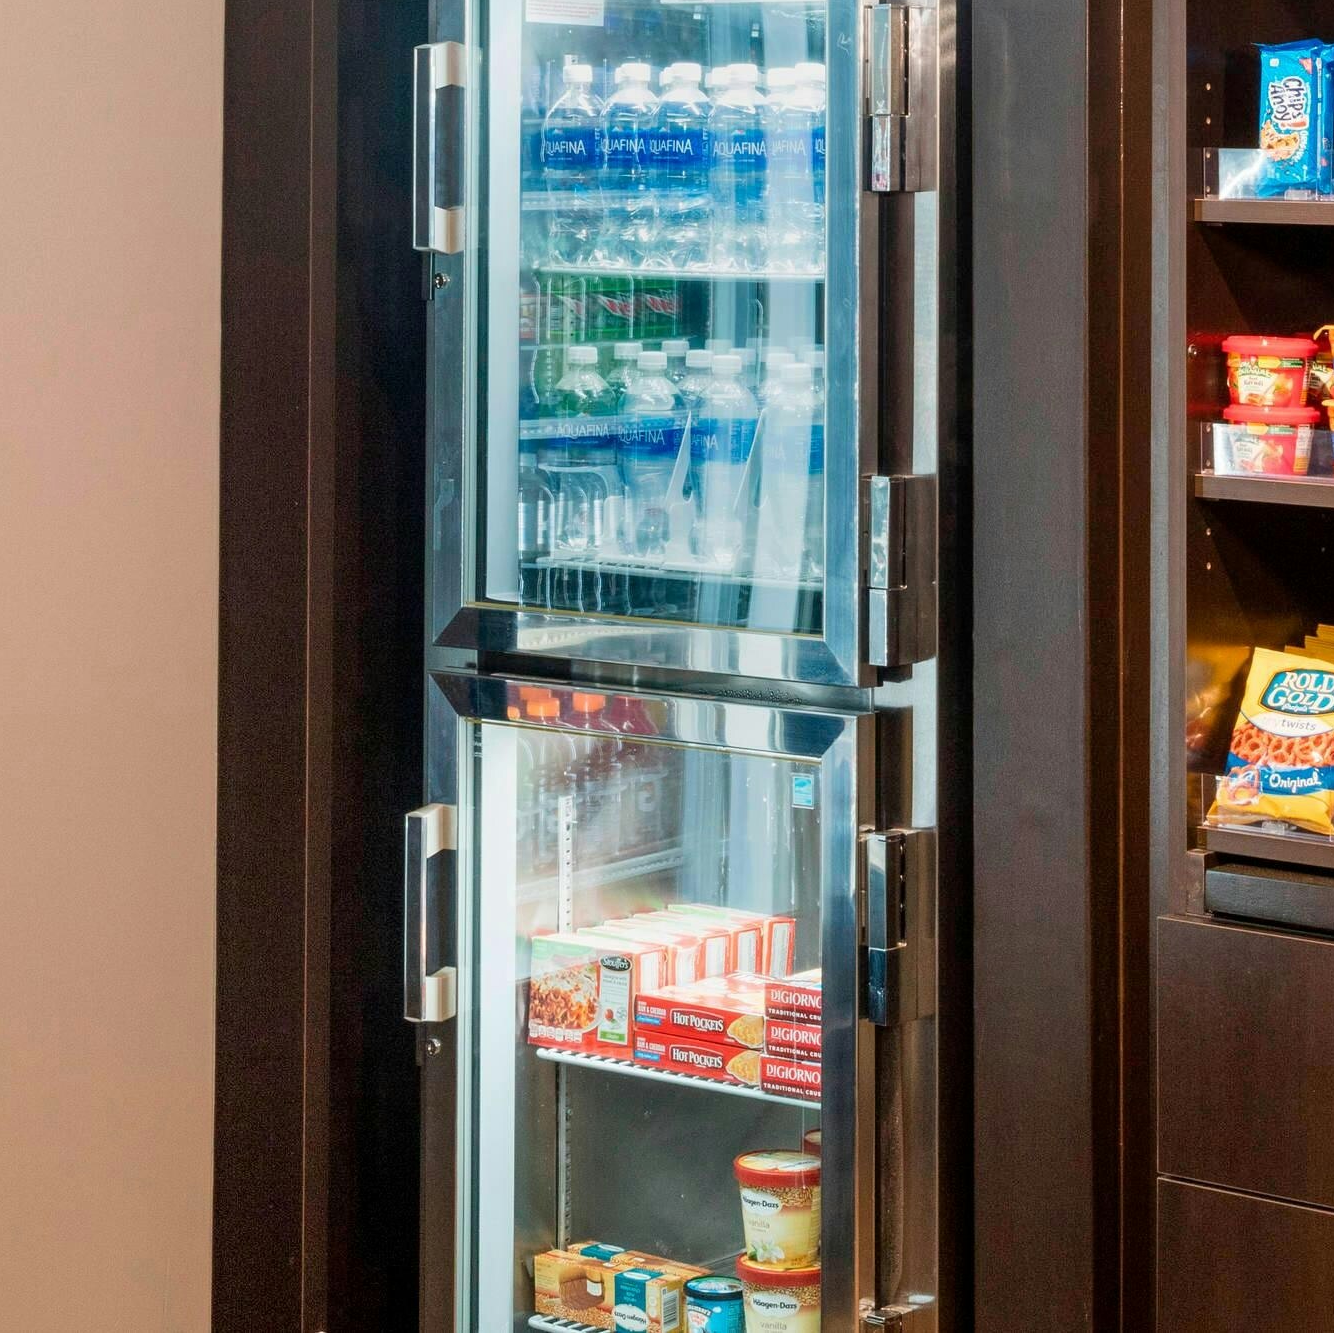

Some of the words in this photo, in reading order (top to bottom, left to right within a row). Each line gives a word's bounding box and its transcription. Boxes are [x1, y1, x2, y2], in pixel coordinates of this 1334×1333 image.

[1282, 76, 1306, 120] Chips
[546, 139, 588, 156] QUAFINA
[649, 138, 694, 156] QUAFINA
[712, 140, 768, 158] AQUAFINA
[1280, 718, 1317, 731] twists
[1269, 771, 1322, 793] Original
[673, 1012, 688, 1025] HOT
[689, 1015, 724, 1032] POCKETS
[768, 1008, 808, 1019] TRADITIONAL
[672, 1048, 688, 1061] HOT
[689, 1051, 723, 1068] POCKETS
[768, 1045, 808, 1057] TRADITIONAL
[809, 1050, 822, 1059] CRU
[766, 1063, 822, 1083] DIGIORNO
[763, 1083, 804, 1094] TRADITIONAL
[805, 1089, 822, 1097] CRUS
[760, 1320, 788, 1331] vanilla
